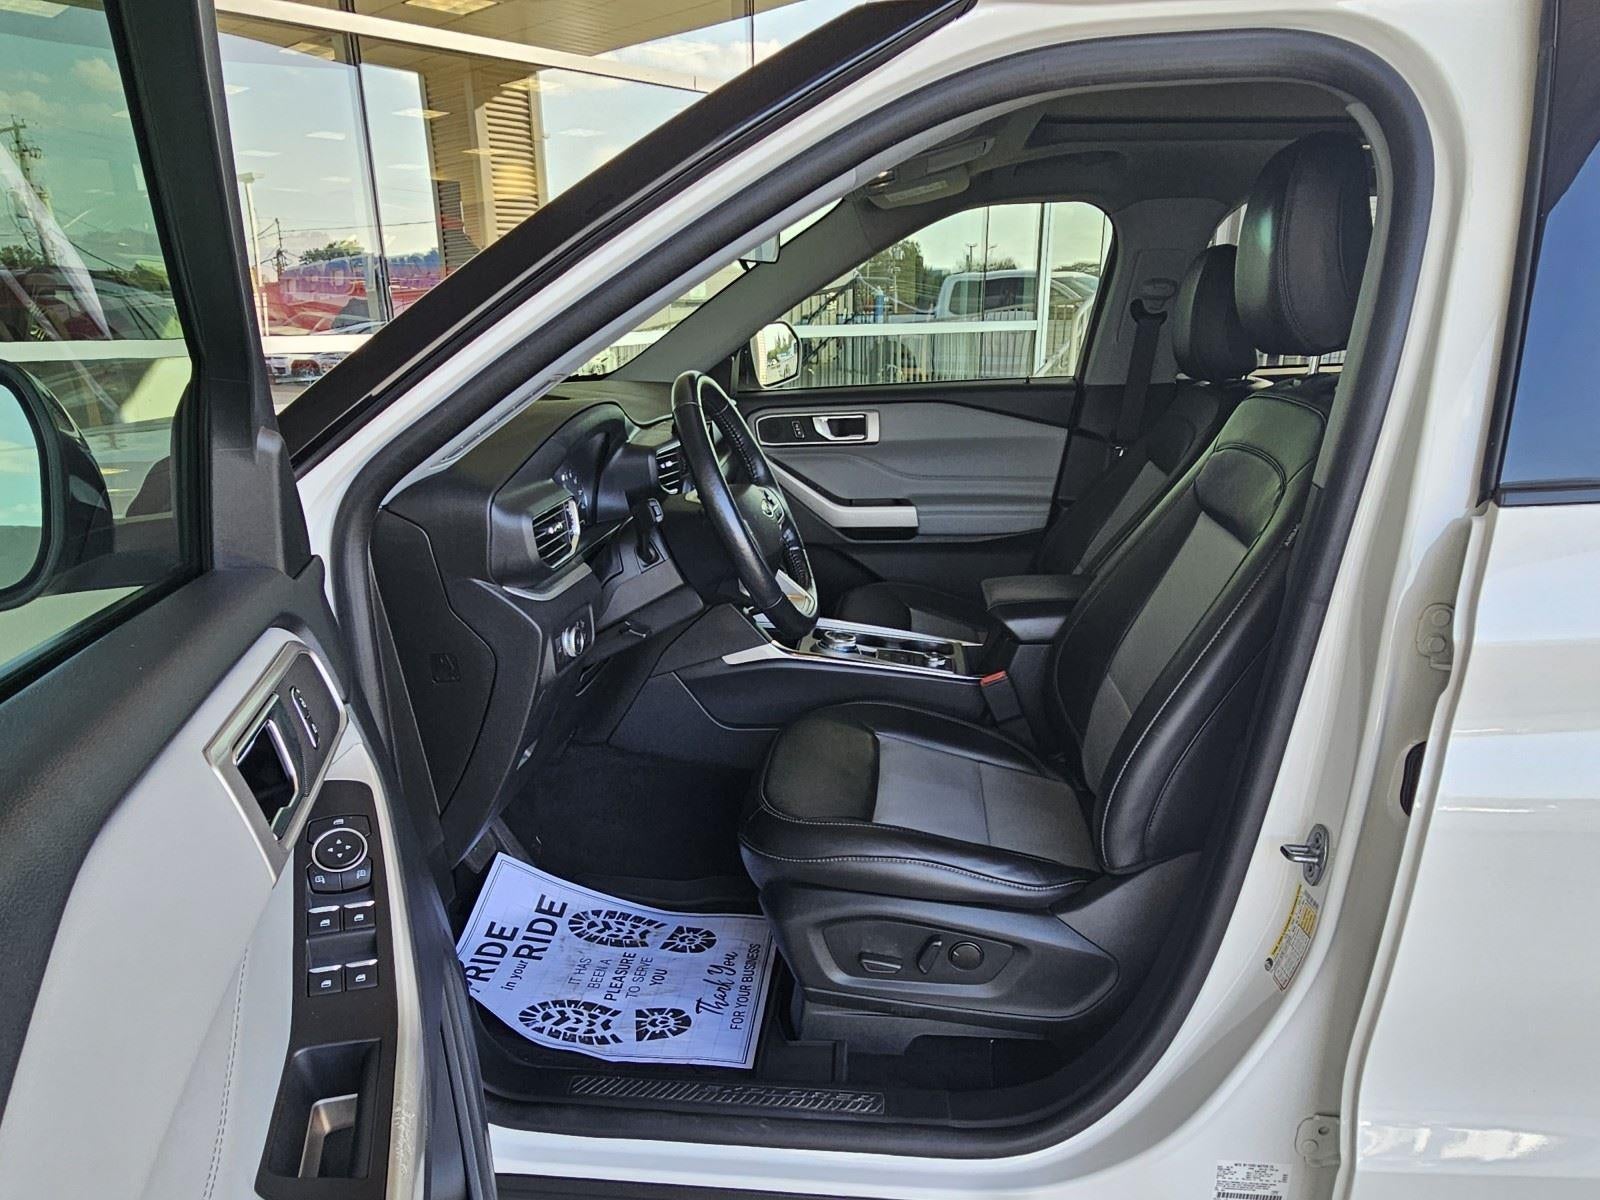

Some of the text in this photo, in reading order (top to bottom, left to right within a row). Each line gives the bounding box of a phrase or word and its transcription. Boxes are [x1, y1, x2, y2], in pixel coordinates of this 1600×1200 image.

[465, 921, 519, 993] RIDE
[501, 894, 568, 991] in your RIDE
[568, 957, 592, 985] IT HAS
[587, 958, 612, 989] BEEN A
[604, 952, 637, 1001] PLEASURE
[625, 956, 653, 999] TO SERVE
[649, 969, 667, 986] YOU
[696, 951, 739, 1015] Thank You
[730, 943, 761, 1030] FOR YOUR BUSINESS
